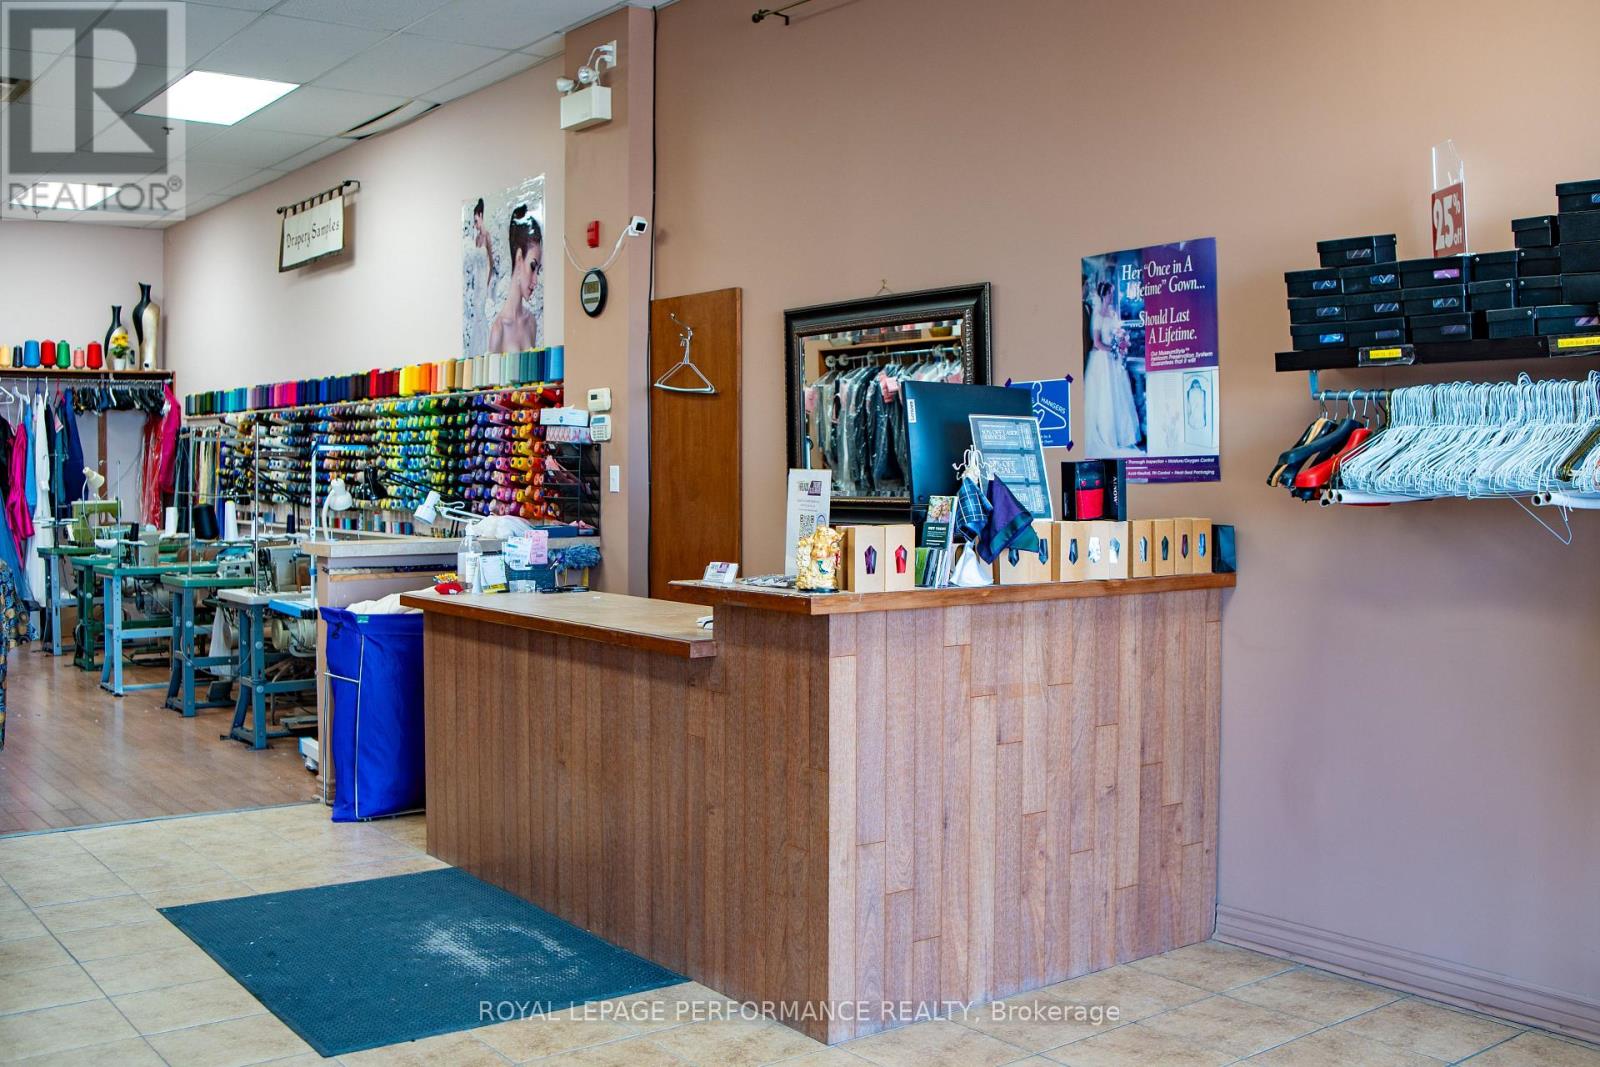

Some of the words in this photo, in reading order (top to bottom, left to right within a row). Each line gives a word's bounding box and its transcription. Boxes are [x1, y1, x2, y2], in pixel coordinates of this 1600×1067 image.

[286, 230, 311, 250] Drapery
[311, 217, 340, 240] Samples
[1122, 264, 1142, 280] Her
[1173, 259, 1182, 274] in
[1183, 254, 1193, 273] A
[1170, 307, 1190, 324] Last
[1148, 327, 1156, 345] A
[1159, 325, 1197, 347] Lifetime.
[1041, 396, 1067, 415] HANGERS
